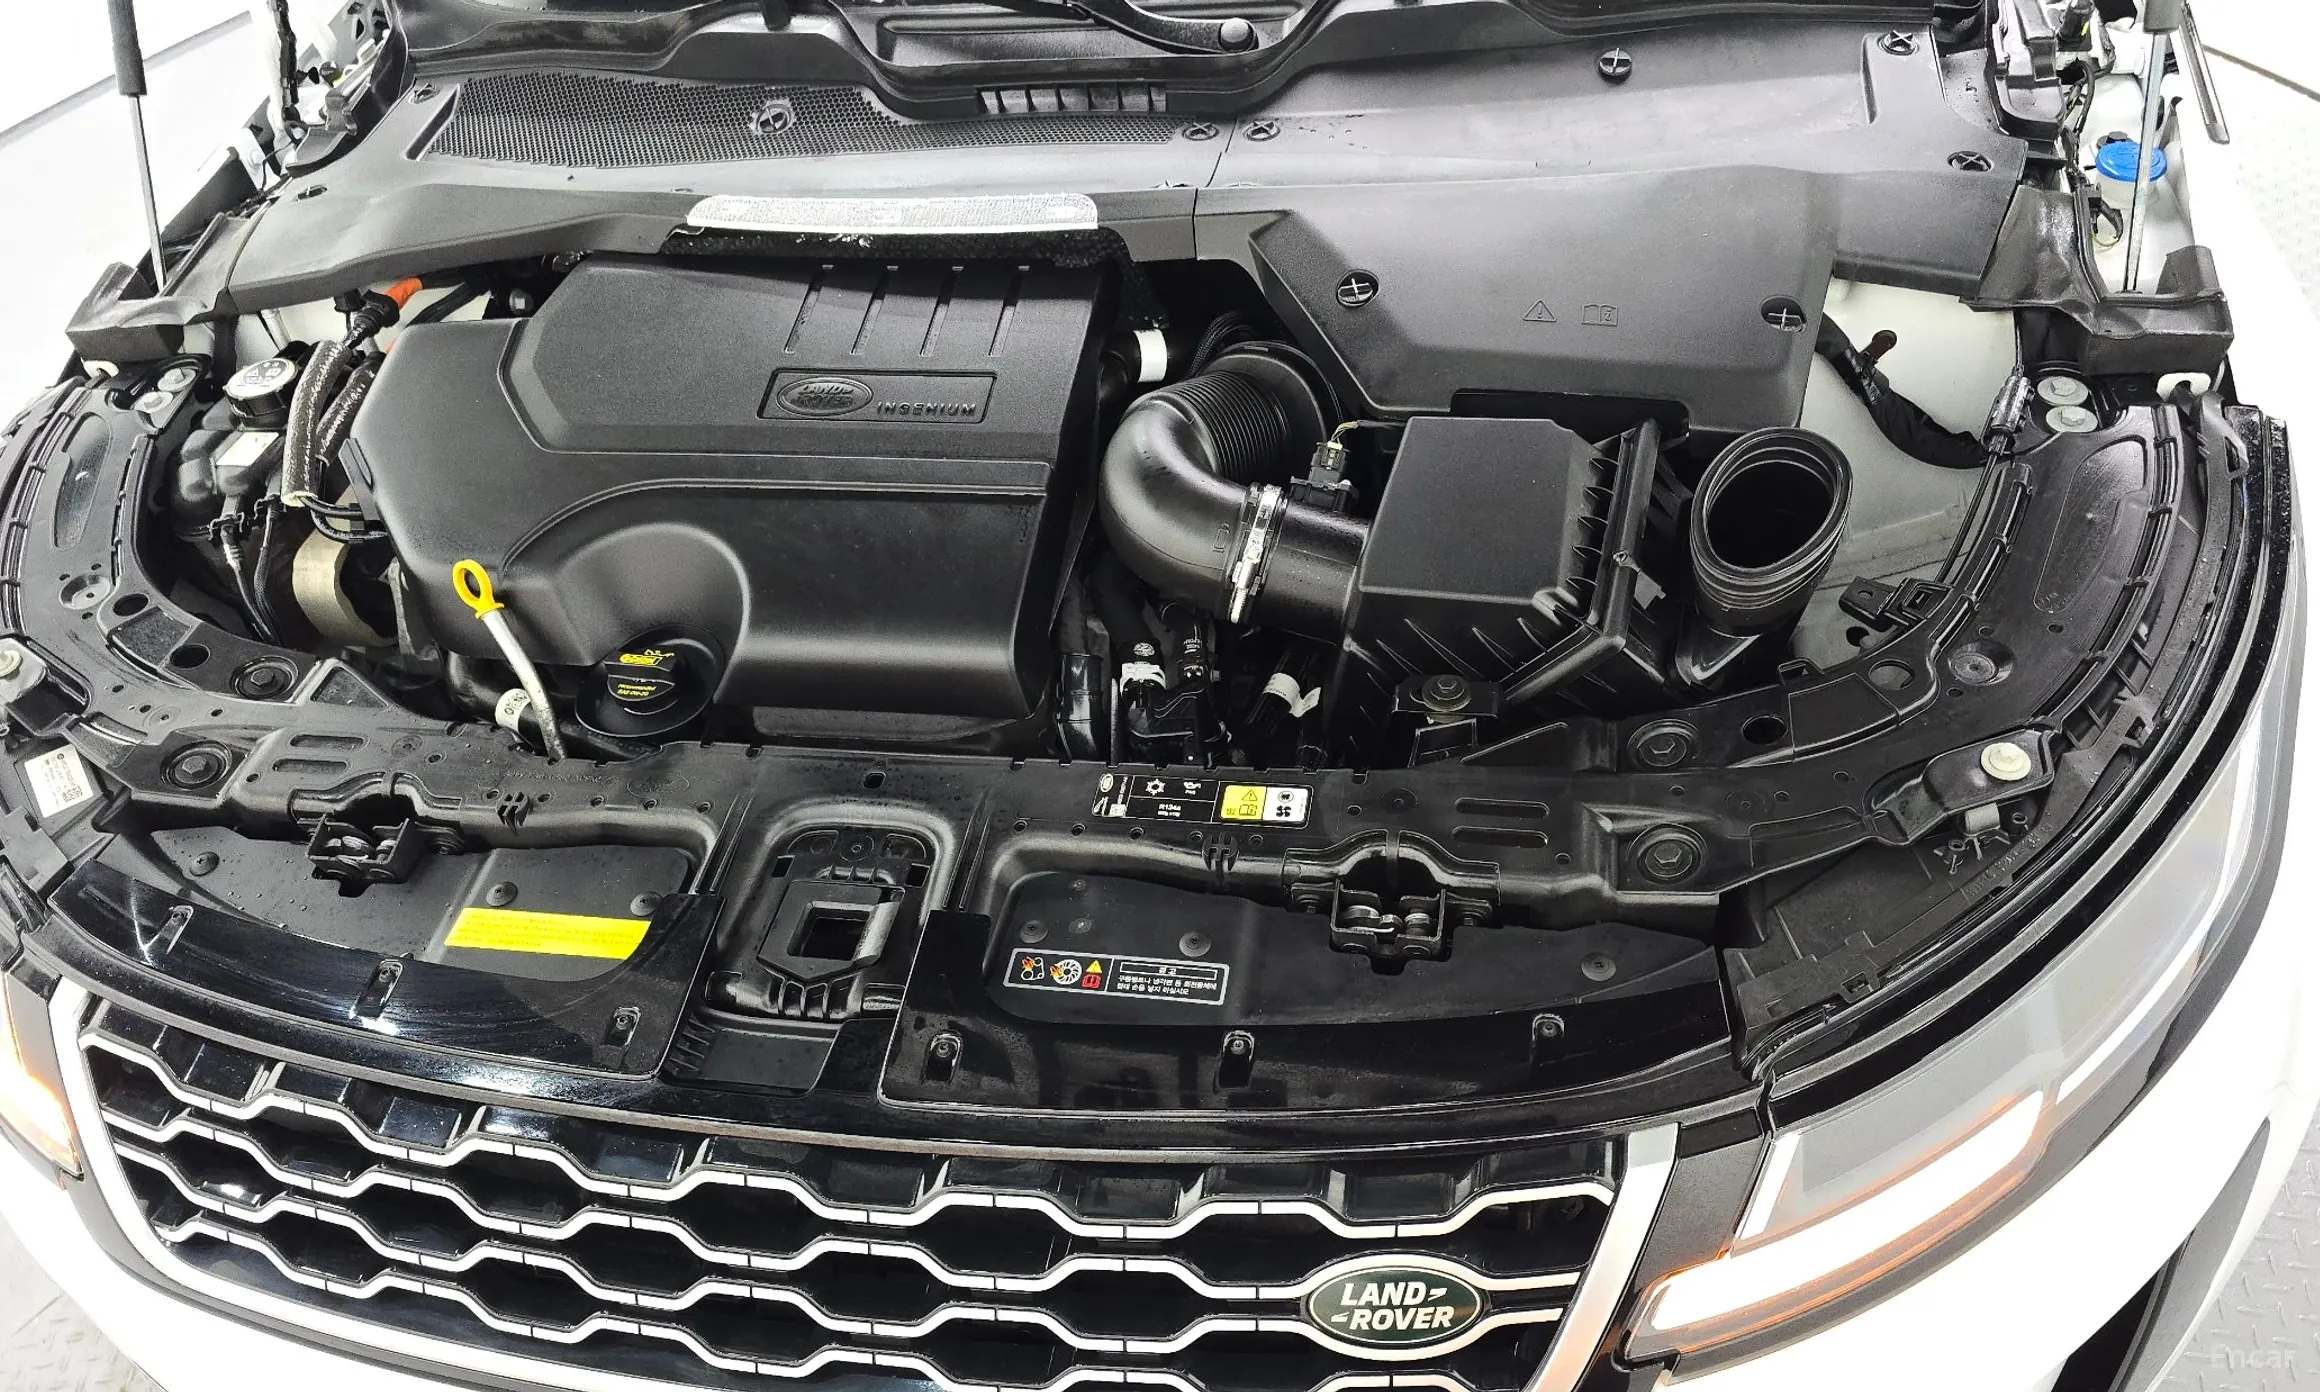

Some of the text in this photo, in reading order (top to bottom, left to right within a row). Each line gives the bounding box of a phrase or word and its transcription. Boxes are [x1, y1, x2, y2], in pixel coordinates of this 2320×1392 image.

[877, 402, 976, 416] INGENIUM
[1340, 1281, 1427, 1306] LAND
[1349, 1306, 1455, 1331] ROVER
